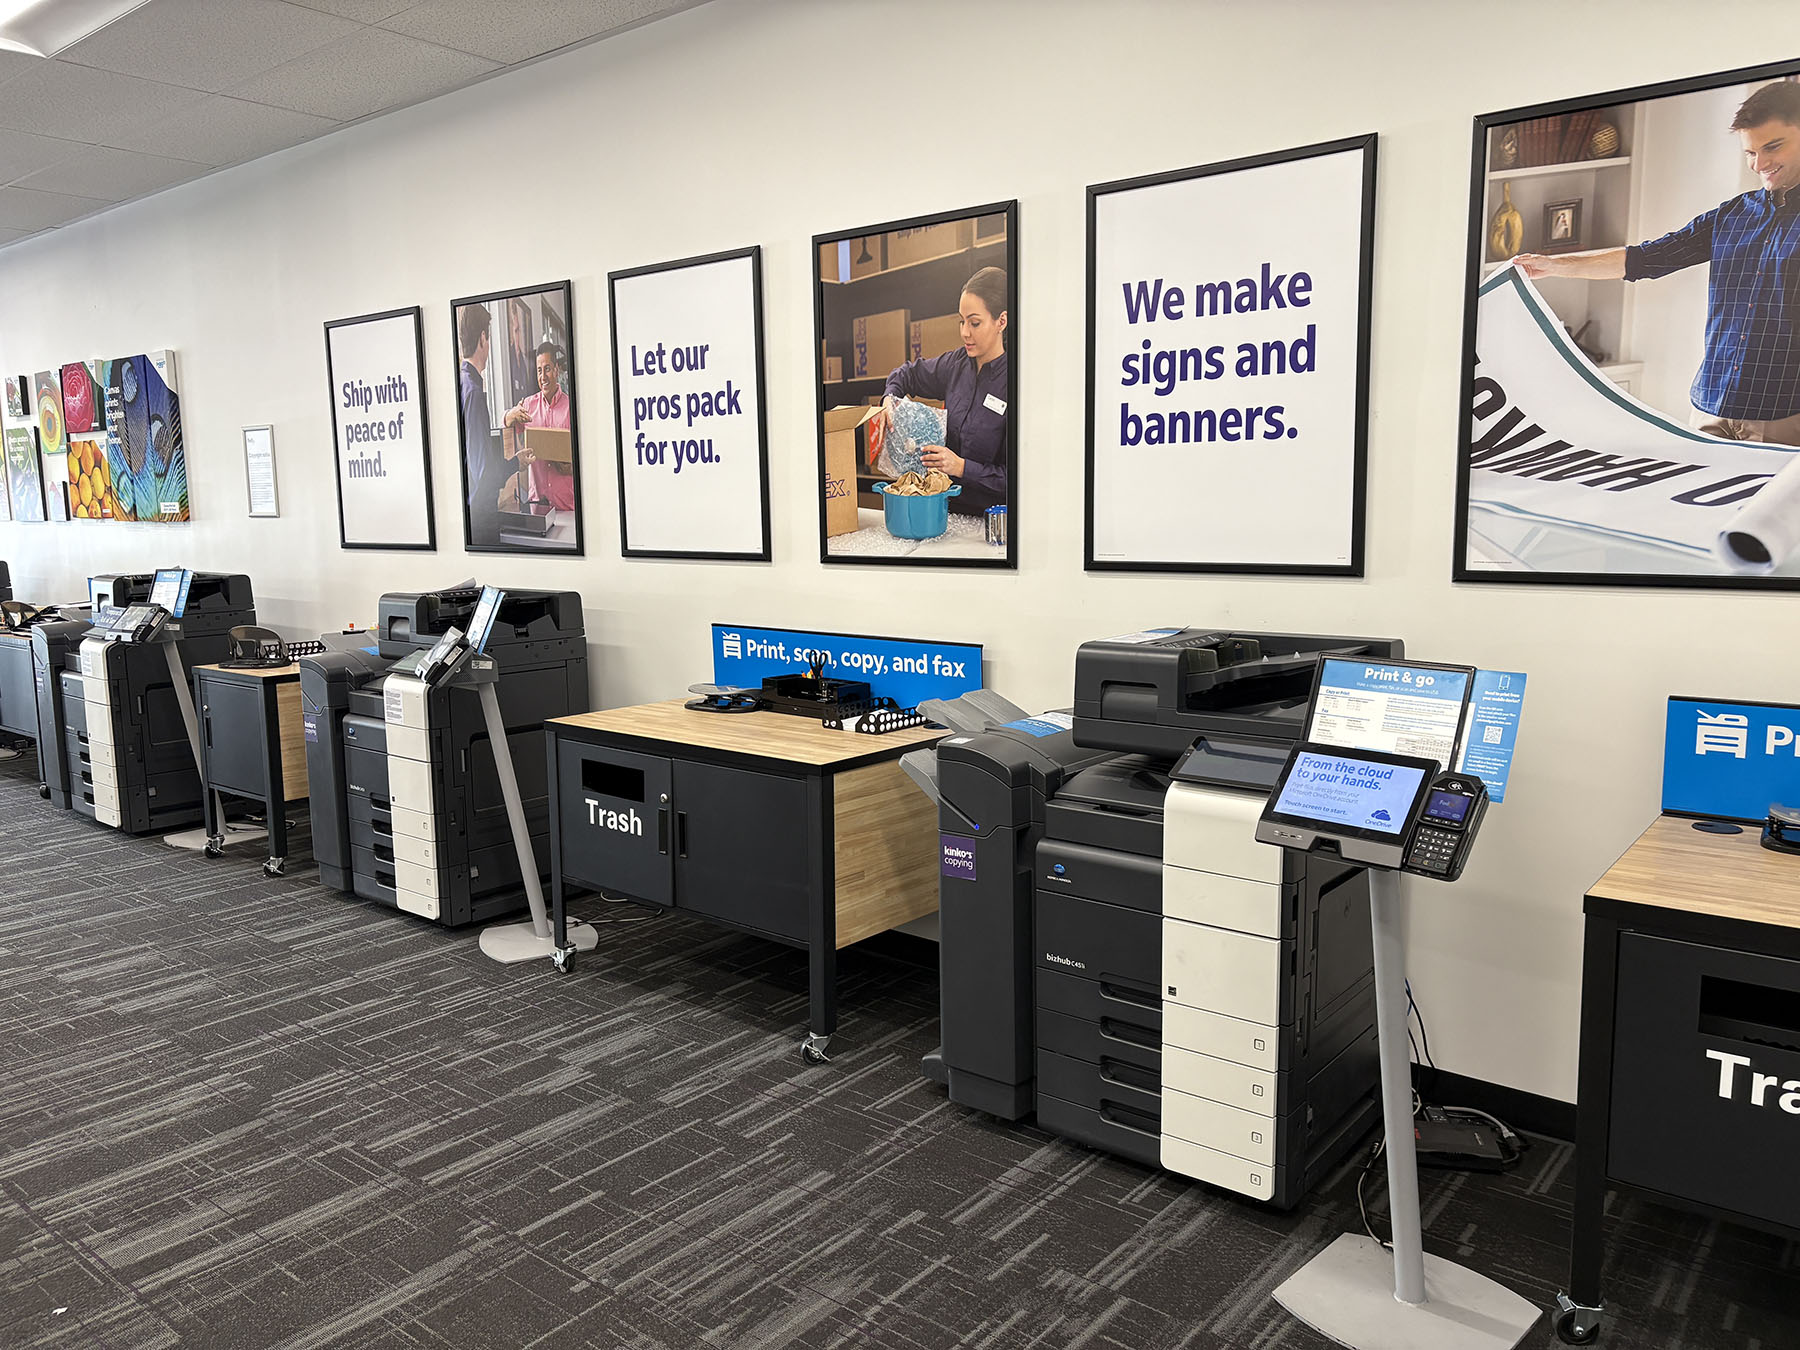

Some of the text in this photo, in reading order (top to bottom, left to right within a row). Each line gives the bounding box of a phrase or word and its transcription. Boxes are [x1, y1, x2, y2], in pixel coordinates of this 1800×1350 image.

[1122, 262, 1313, 325] We make
[631, 342, 709, 376] Let our
[1120, 323, 1317, 396] signs and
[342, 374, 408, 413] Ship with
[633, 380, 742, 430] pros pack
[345, 411, 404, 450] peace of
[1120, 402, 1298, 446] banners.
[348, 450, 387, 478] mind.
[635, 432, 721, 474] for you.
[746, 638, 790, 664] Print,
[841, 652, 889, 676] copy,
[892, 653, 928, 674] and
[931, 655, 966, 679] fax
[1364, 667, 1435, 688] Print & go
[1297, 767, 1382, 791] to your hands.
[1300, 756, 1394, 780] From the cloud
[585, 798, 642, 836] Trash
[1284, 799, 1302, 808] Touch
[1302, 803, 1323, 812] screen
[1323, 804, 1330, 812] to
[1365, 818, 1392, 829] OneDrive
[944, 856, 973, 871] copying
[1046, 952, 1071, 966] bizhub
[1706, 1049, 1800, 1114] Tra
